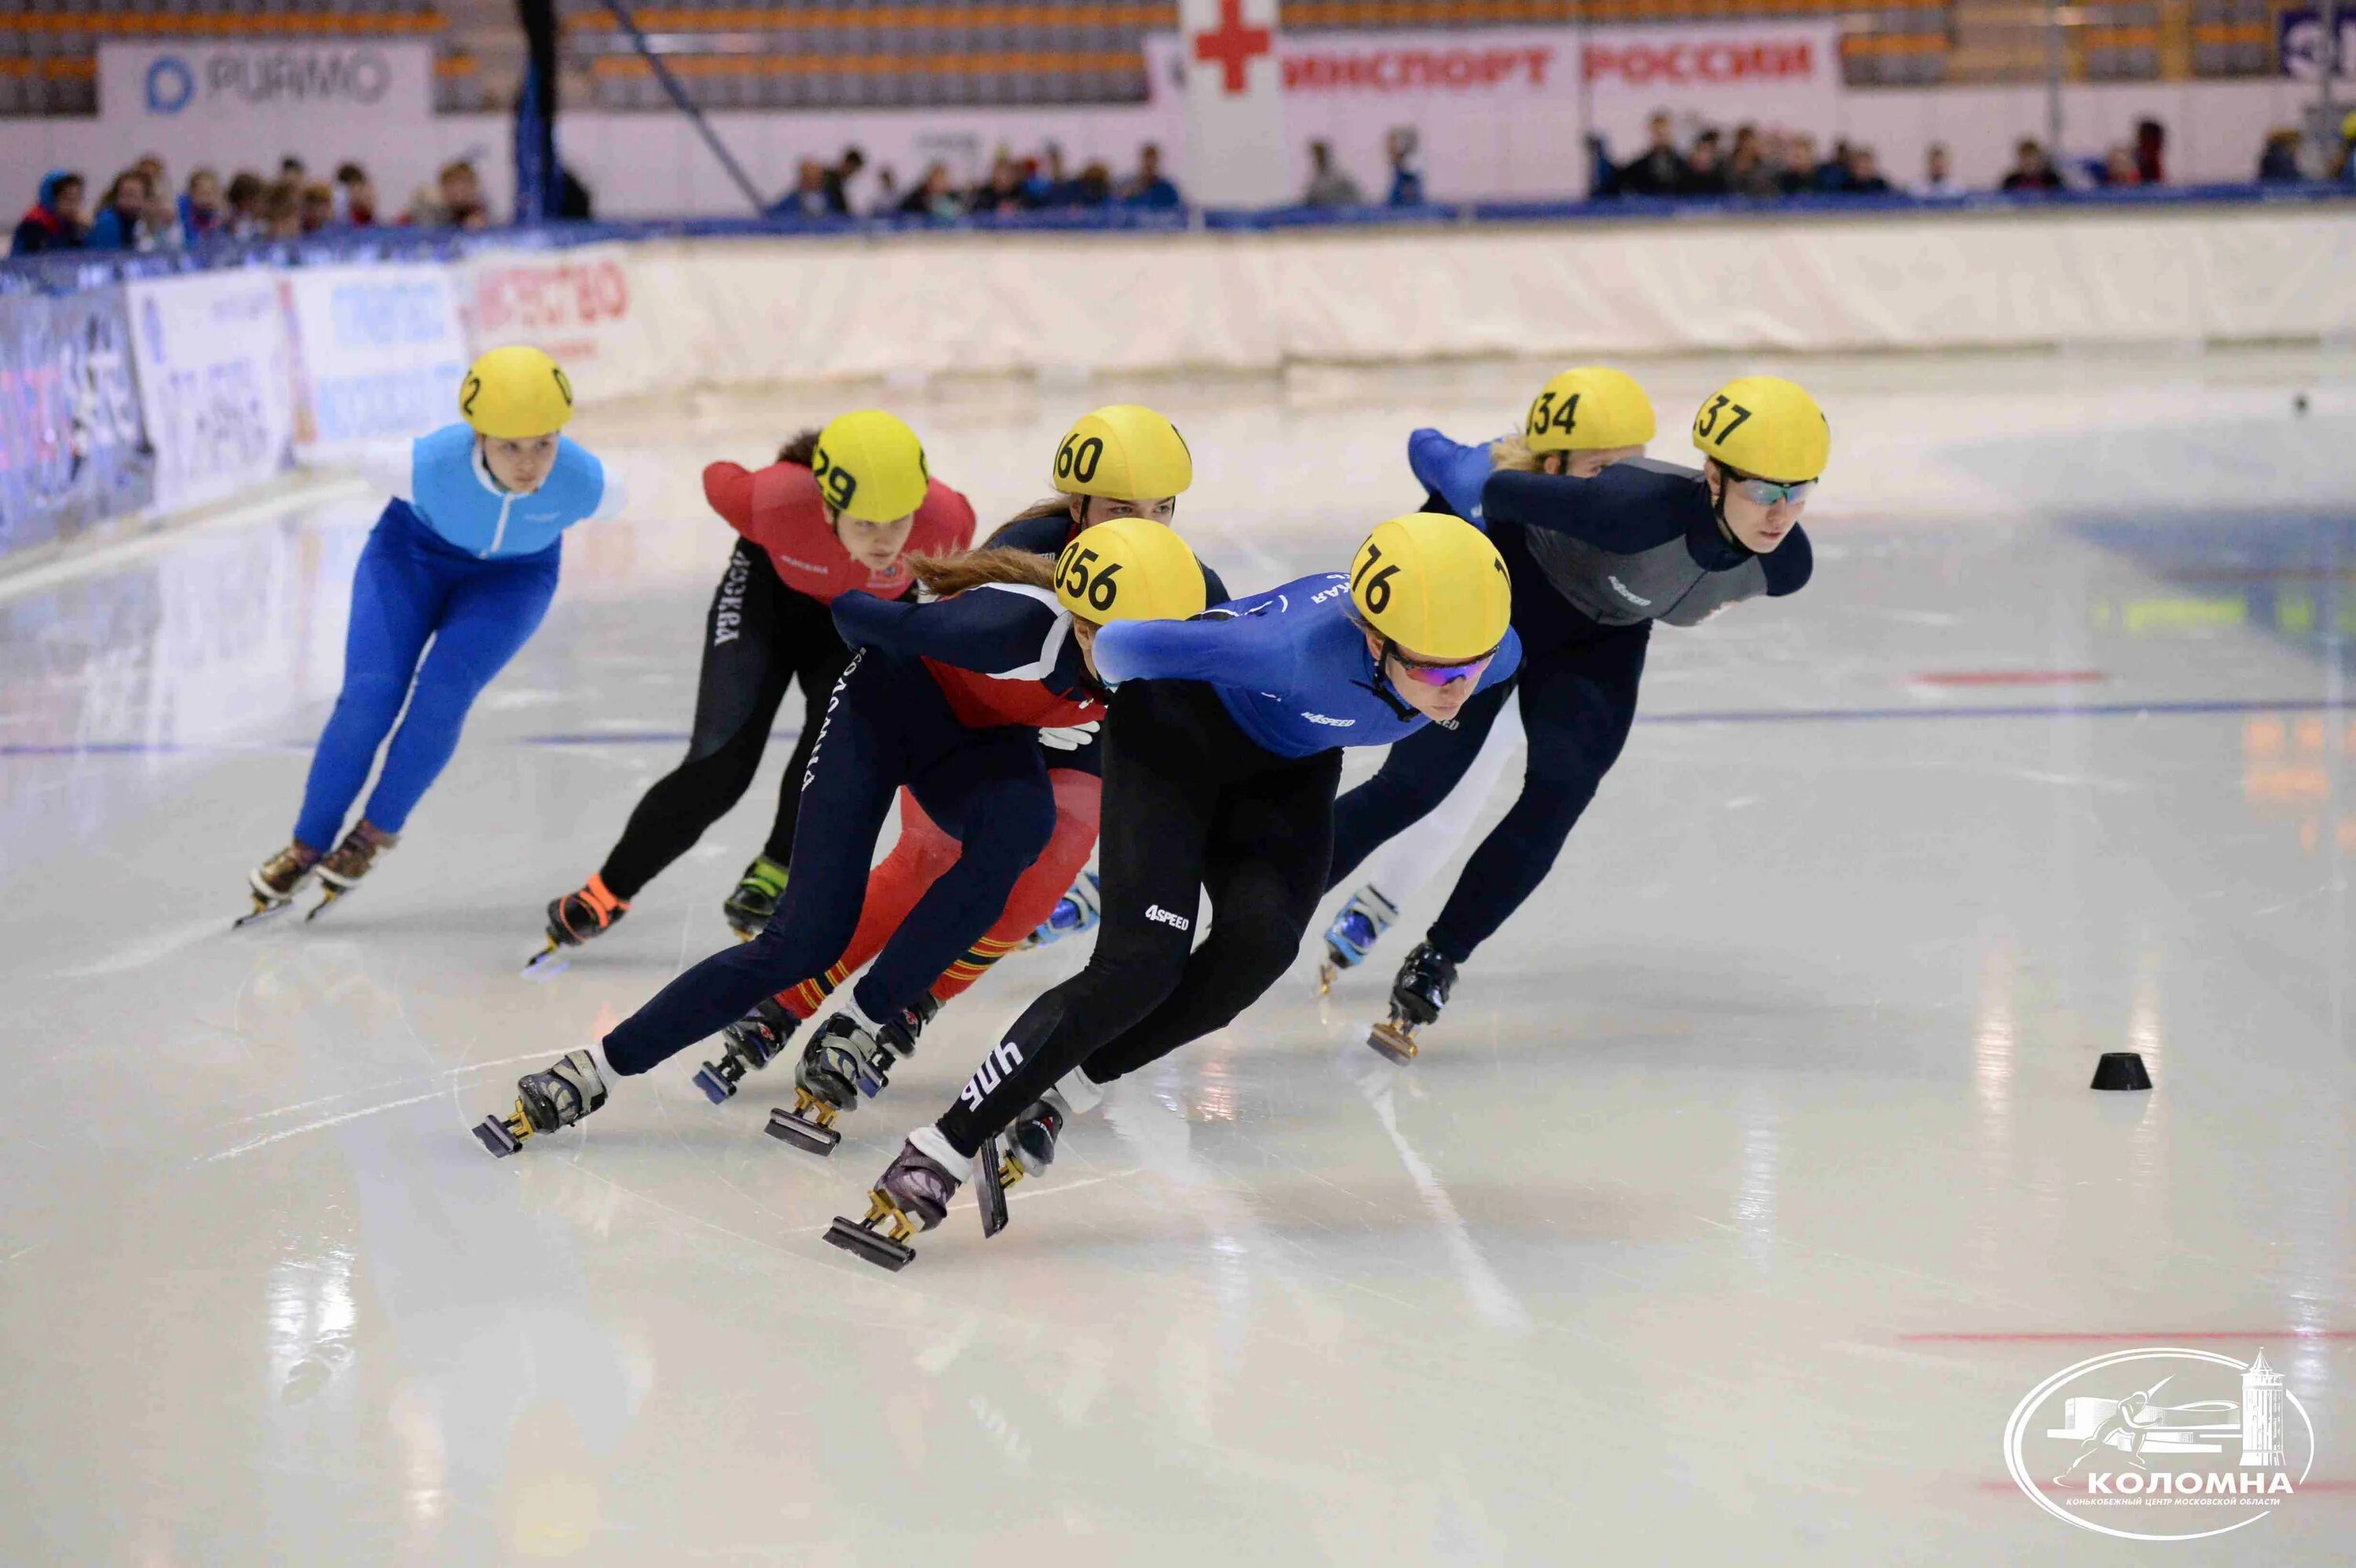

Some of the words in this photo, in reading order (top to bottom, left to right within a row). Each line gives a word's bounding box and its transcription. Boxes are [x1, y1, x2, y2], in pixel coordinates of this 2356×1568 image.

[1282, 47, 1553, 92] ИНСПОРТ
[1583, 42, 1814, 85] РОССИИ
[463, 371, 481, 417] 2
[1694, 394, 1752, 446] 37
[1054, 433, 1103, 484] 60
[1055, 542, 1123, 611] 056
[1352, 535, 1401, 615] 76
[1145, 905, 1189, 931] 4SPEED
